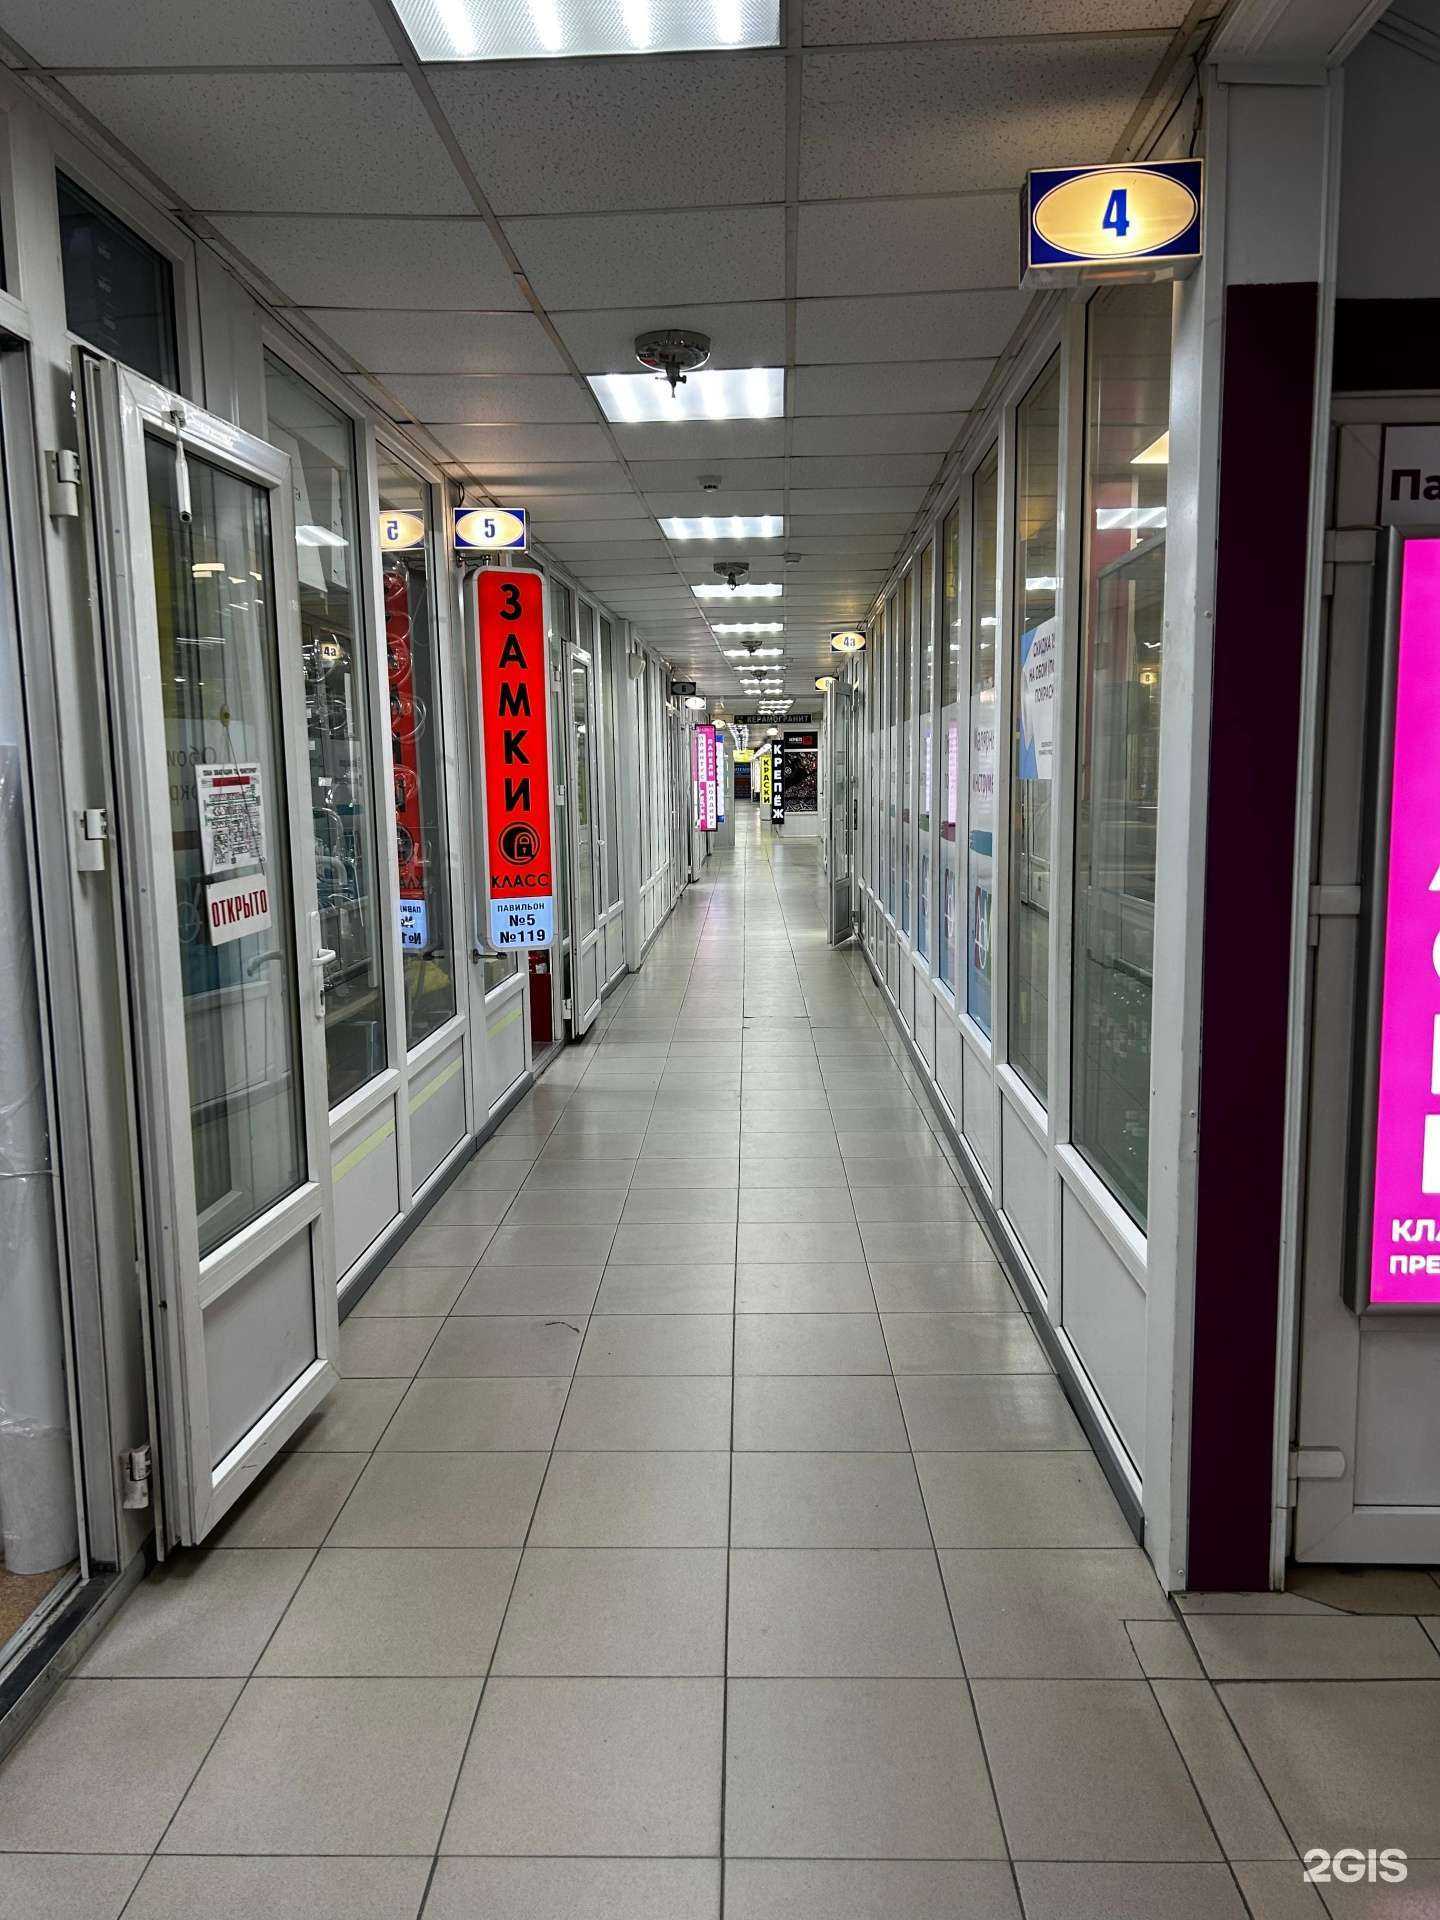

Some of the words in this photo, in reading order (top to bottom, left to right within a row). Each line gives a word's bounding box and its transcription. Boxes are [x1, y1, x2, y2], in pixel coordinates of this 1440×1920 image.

[1102, 188, 1130, 237] 4
[1390, 469, 1440, 501] Па
[484, 518, 496, 539] 5
[498, 583, 531, 813] ЗАМКИ
[491, 873, 550, 889] КЛАСС
[211, 889, 268, 928] ОТКРЫТО
[497, 902, 545, 913] ПАВИЛЬОН
[509, 913, 536, 927] №5
[500, 929, 546, 944] №119
[1389, 1255, 1440, 1275] ПРЕ
